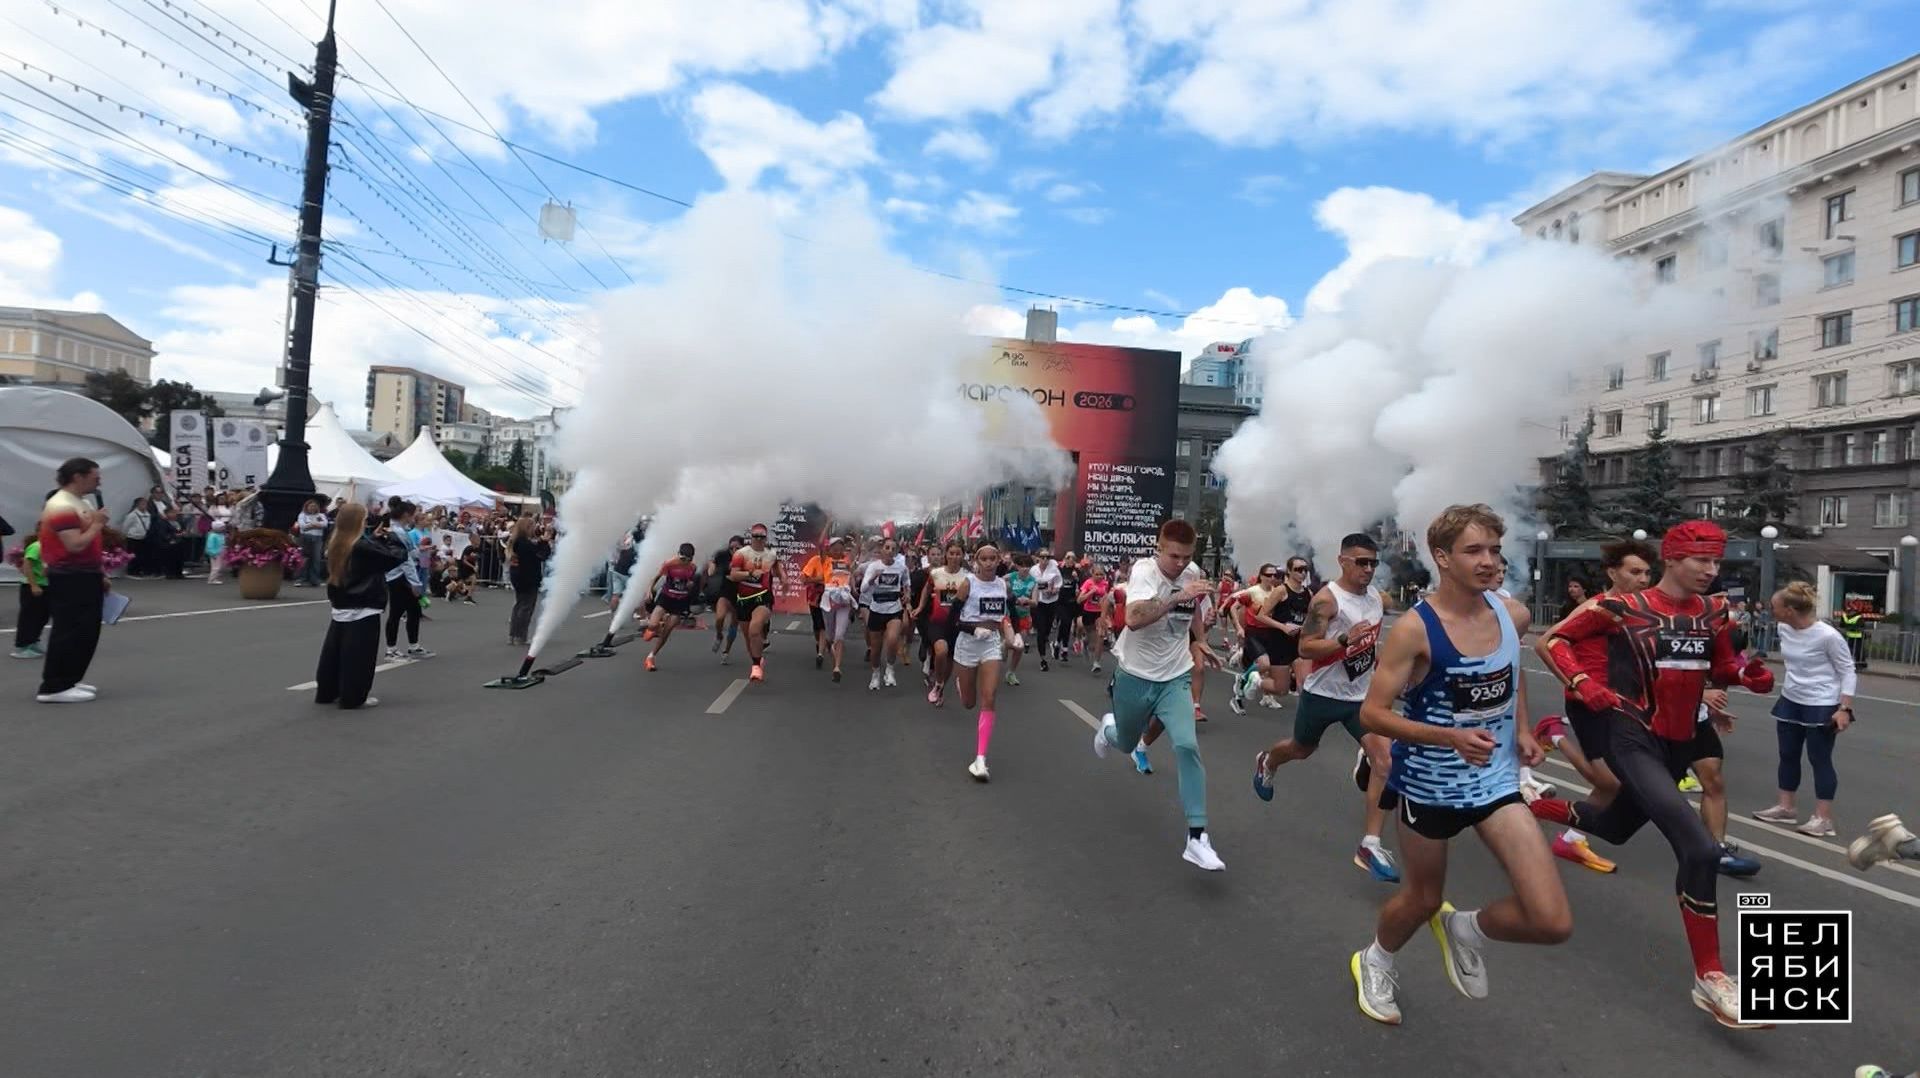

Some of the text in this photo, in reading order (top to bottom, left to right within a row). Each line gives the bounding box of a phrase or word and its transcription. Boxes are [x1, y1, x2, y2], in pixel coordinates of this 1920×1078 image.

[1079, 395, 1113, 408] 2026
[1670, 639, 1705, 654] 9415
[1470, 681, 1506, 702] 9359
